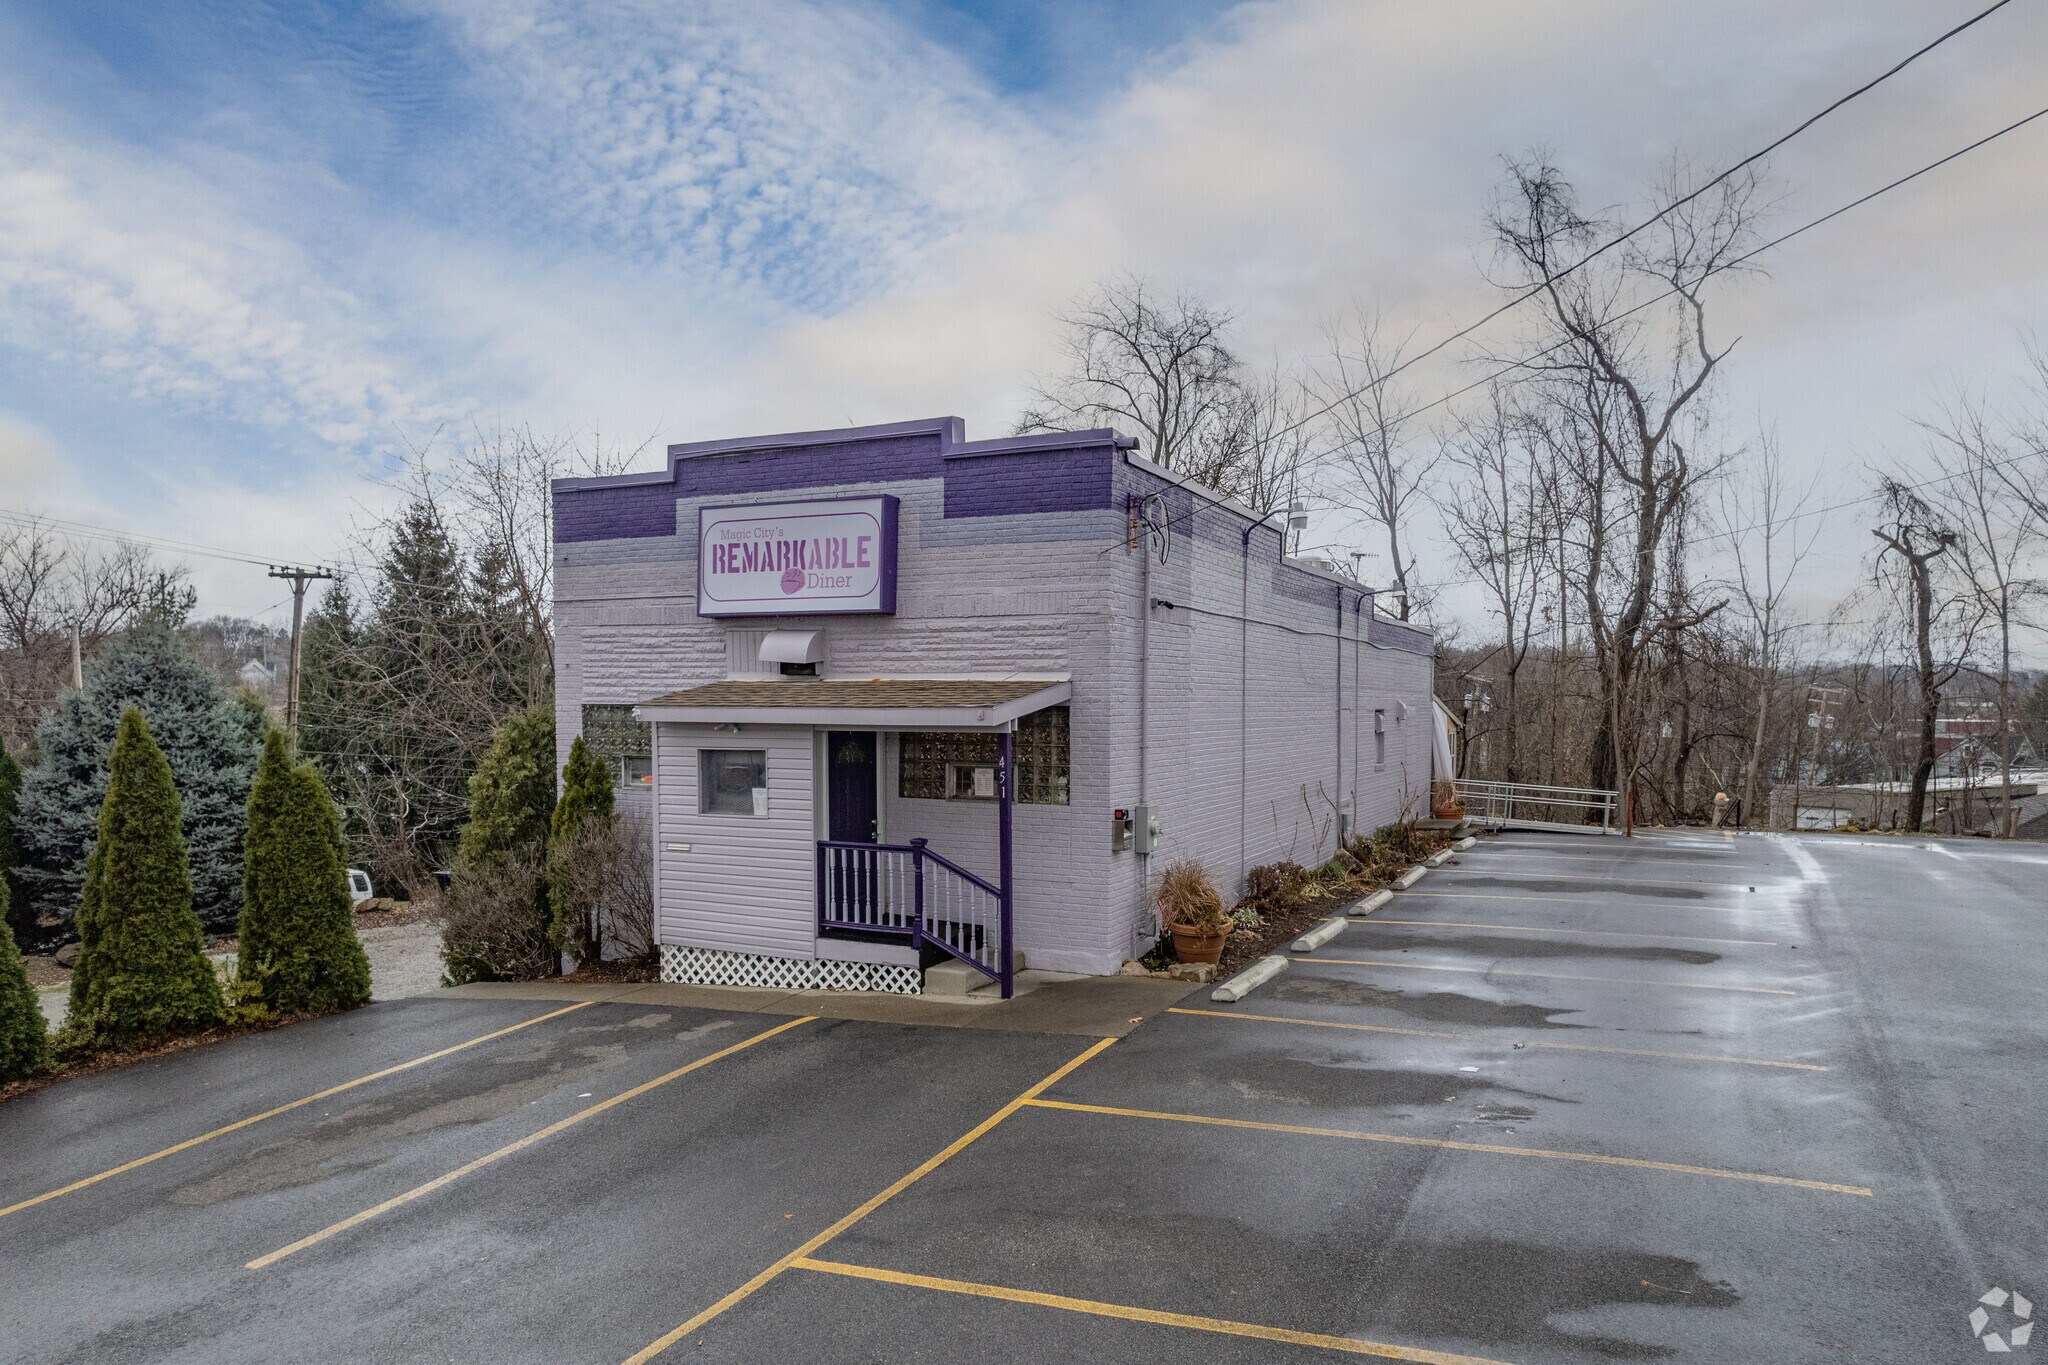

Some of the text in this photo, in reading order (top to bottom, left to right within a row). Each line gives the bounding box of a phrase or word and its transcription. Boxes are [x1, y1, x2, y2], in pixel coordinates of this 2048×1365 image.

[720, 526, 784, 542] Magic City's
[712, 535, 872, 575] REMARKABLE
[807, 573, 853, 589] Diner
[998, 755, 1006, 799] 451
